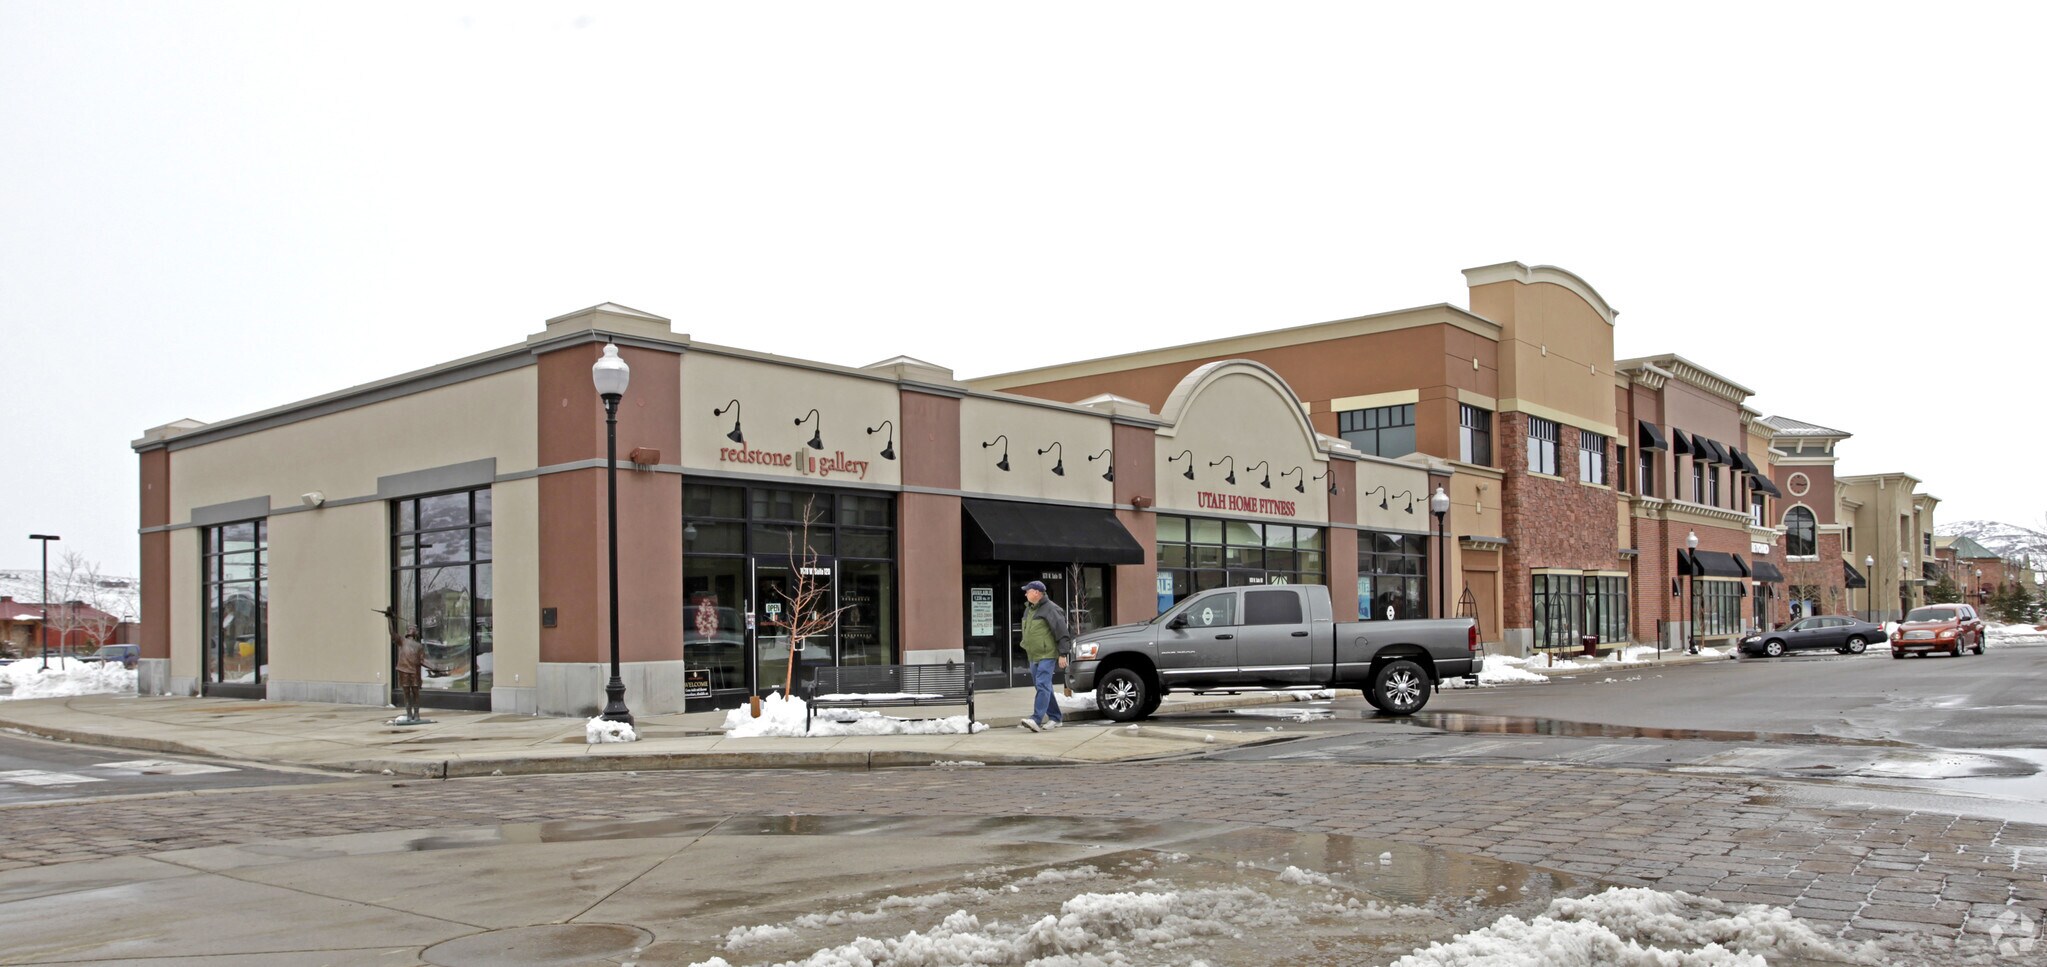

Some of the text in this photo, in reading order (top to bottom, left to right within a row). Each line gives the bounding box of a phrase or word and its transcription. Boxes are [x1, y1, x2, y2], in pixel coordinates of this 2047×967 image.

[720, 441, 869, 479] redstone gallery
[1197, 491, 1295, 516] UTAH HOME FITNESS
[767, 604, 780, 612] OPEN
